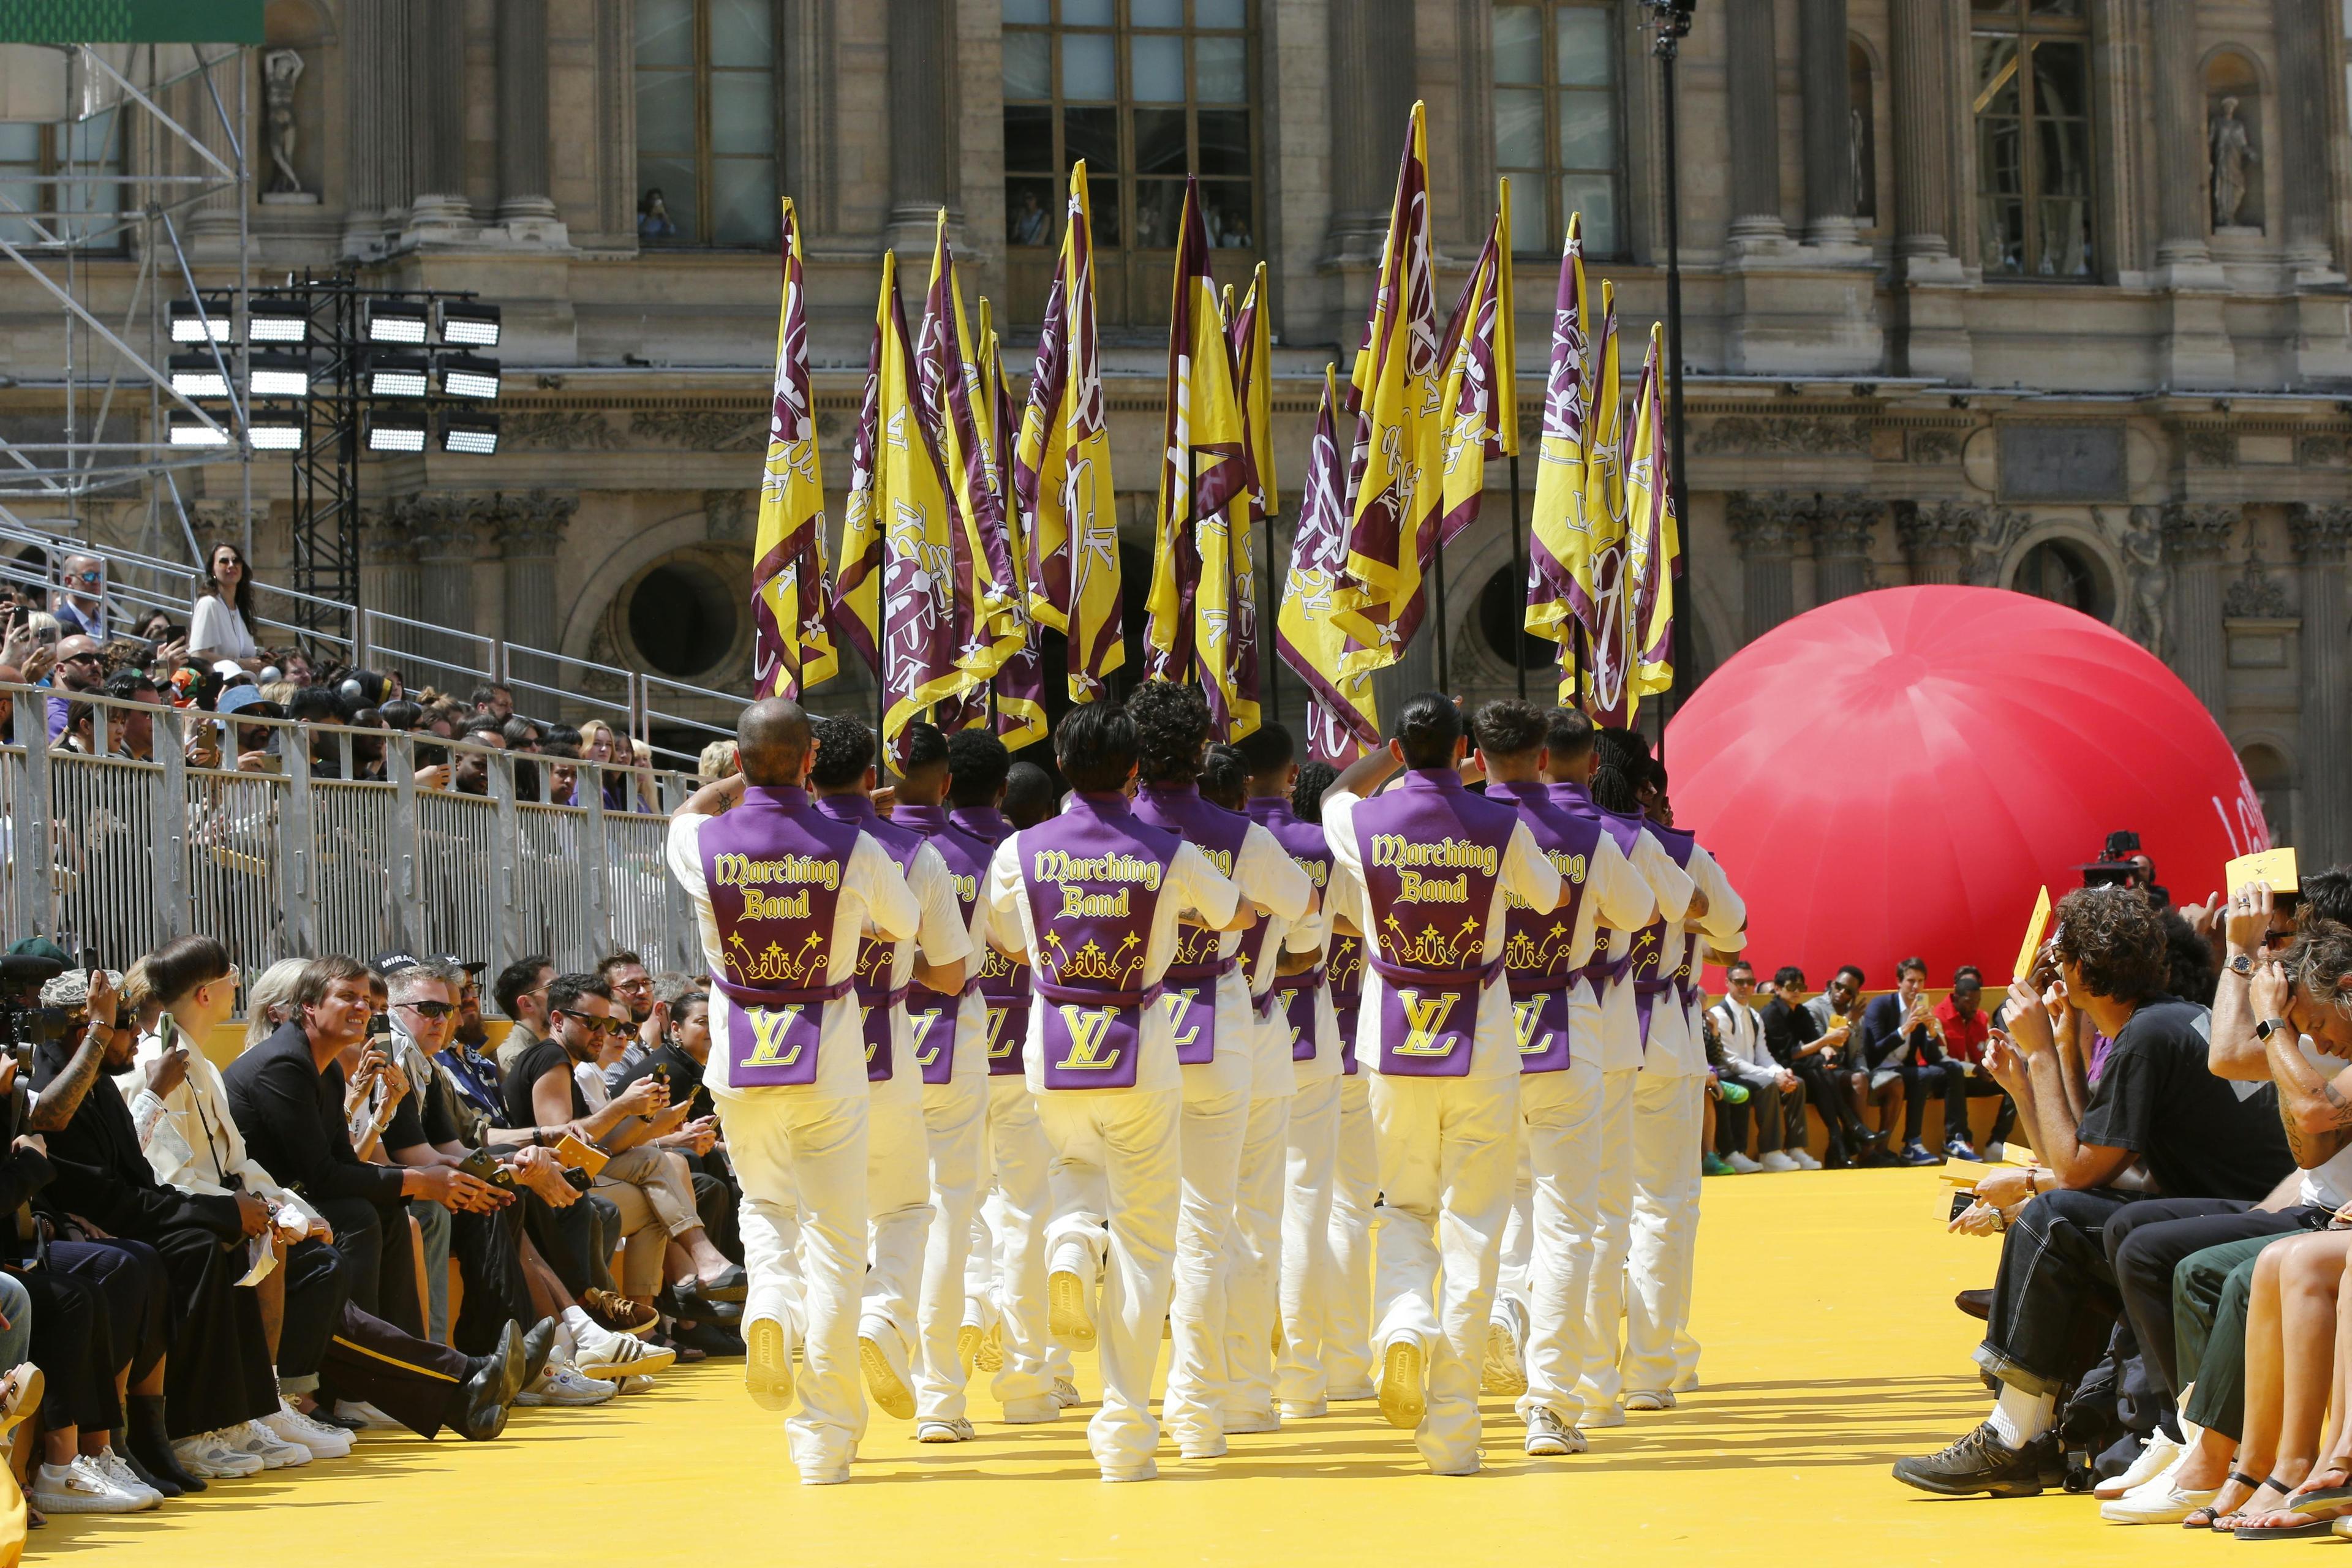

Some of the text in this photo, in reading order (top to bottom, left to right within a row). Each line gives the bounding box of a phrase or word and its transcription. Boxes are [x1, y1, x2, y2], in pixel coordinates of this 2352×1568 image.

[714, 852, 840, 891] Marching
[1035, 850, 1160, 891] Marching
[1371, 833, 1498, 877] Marching
[736, 886, 812, 923] Band
[1053, 882, 1131, 921] Band
[1392, 867, 1469, 905] Band
[761, 1331, 771, 1365] VUITTON
